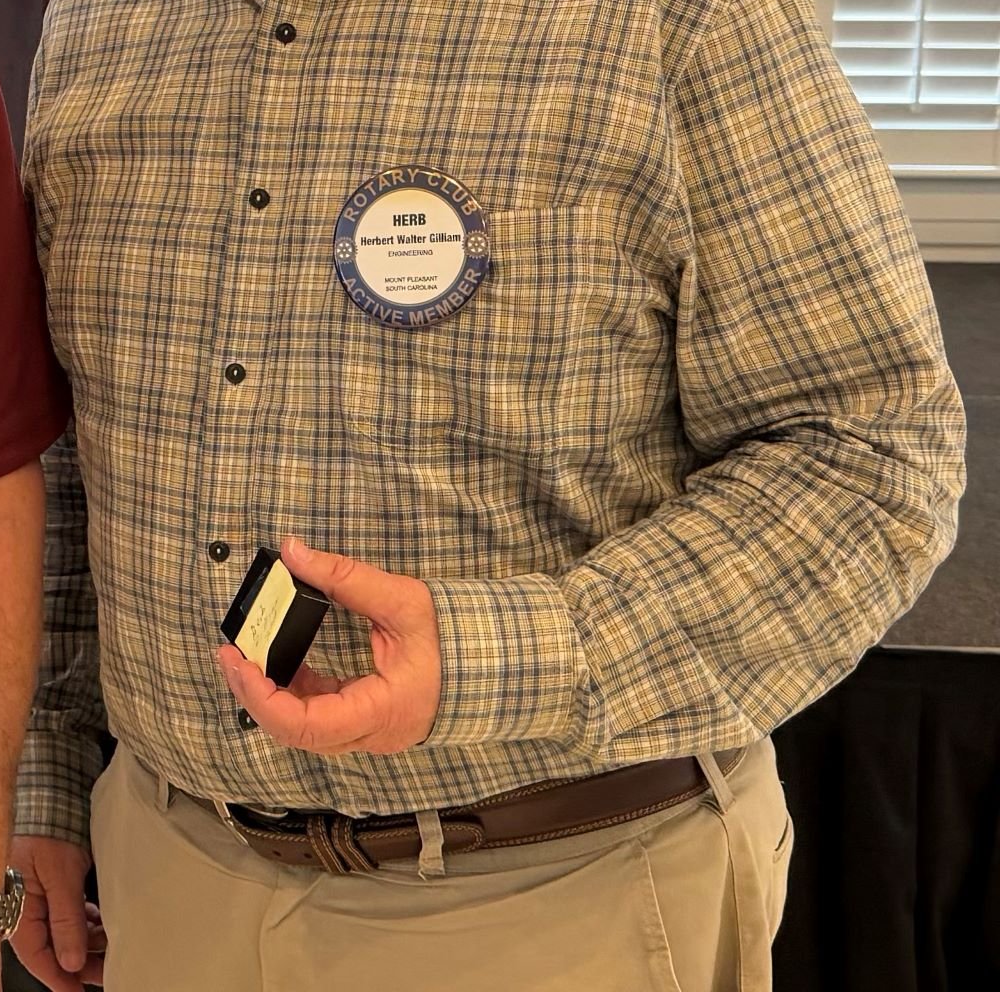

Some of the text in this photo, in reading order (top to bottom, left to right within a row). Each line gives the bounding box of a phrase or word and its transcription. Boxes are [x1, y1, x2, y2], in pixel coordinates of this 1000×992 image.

[343, 168, 477, 222] ROTARY CLUB
[393, 213, 426, 226] HERB
[361, 232, 461, 246] Herbert Walter Gilliam
[388, 249, 433, 257] ENGINEERING
[343, 268, 481, 326] ACTIVE MEMBER
